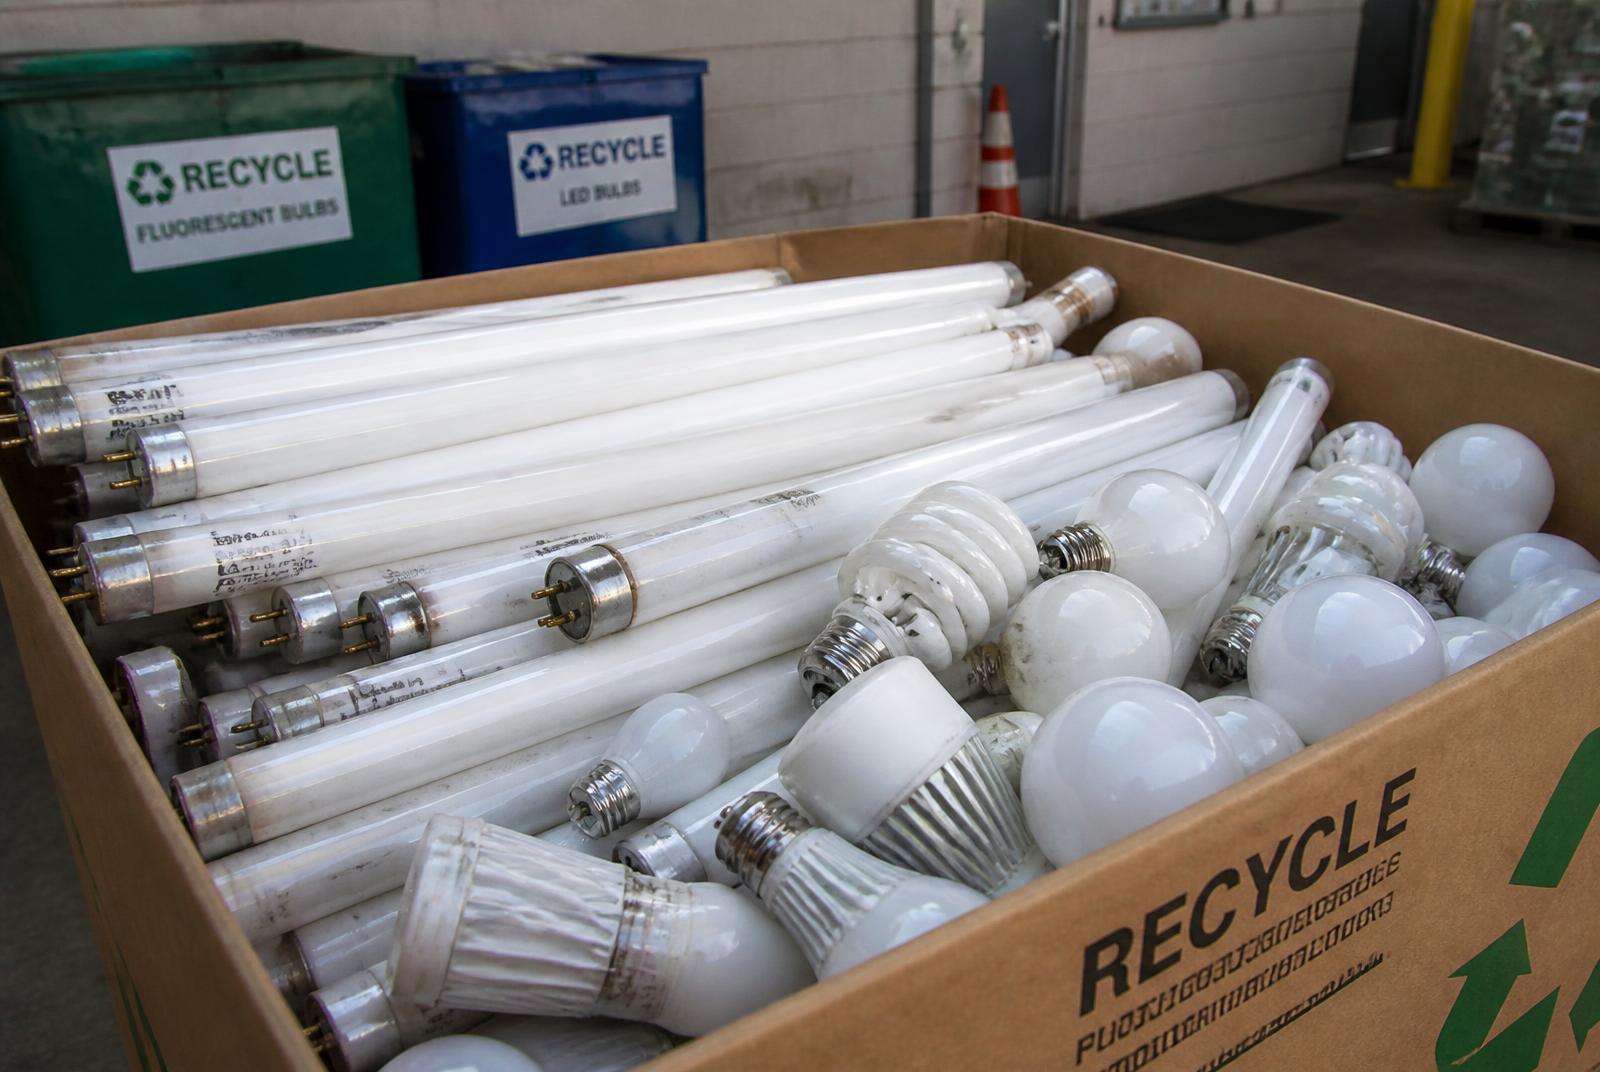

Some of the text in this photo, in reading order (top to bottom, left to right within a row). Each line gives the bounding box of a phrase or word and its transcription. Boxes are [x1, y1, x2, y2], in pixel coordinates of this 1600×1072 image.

[181, 150, 333, 192] RECYCLE
[558, 134, 665, 170] RECYCLE
[560, 180, 641, 207] LED BULBS
[136, 199, 339, 243] FLUORESCENT BULBS
[1079, 768, 1417, 1018] RECYCLE
